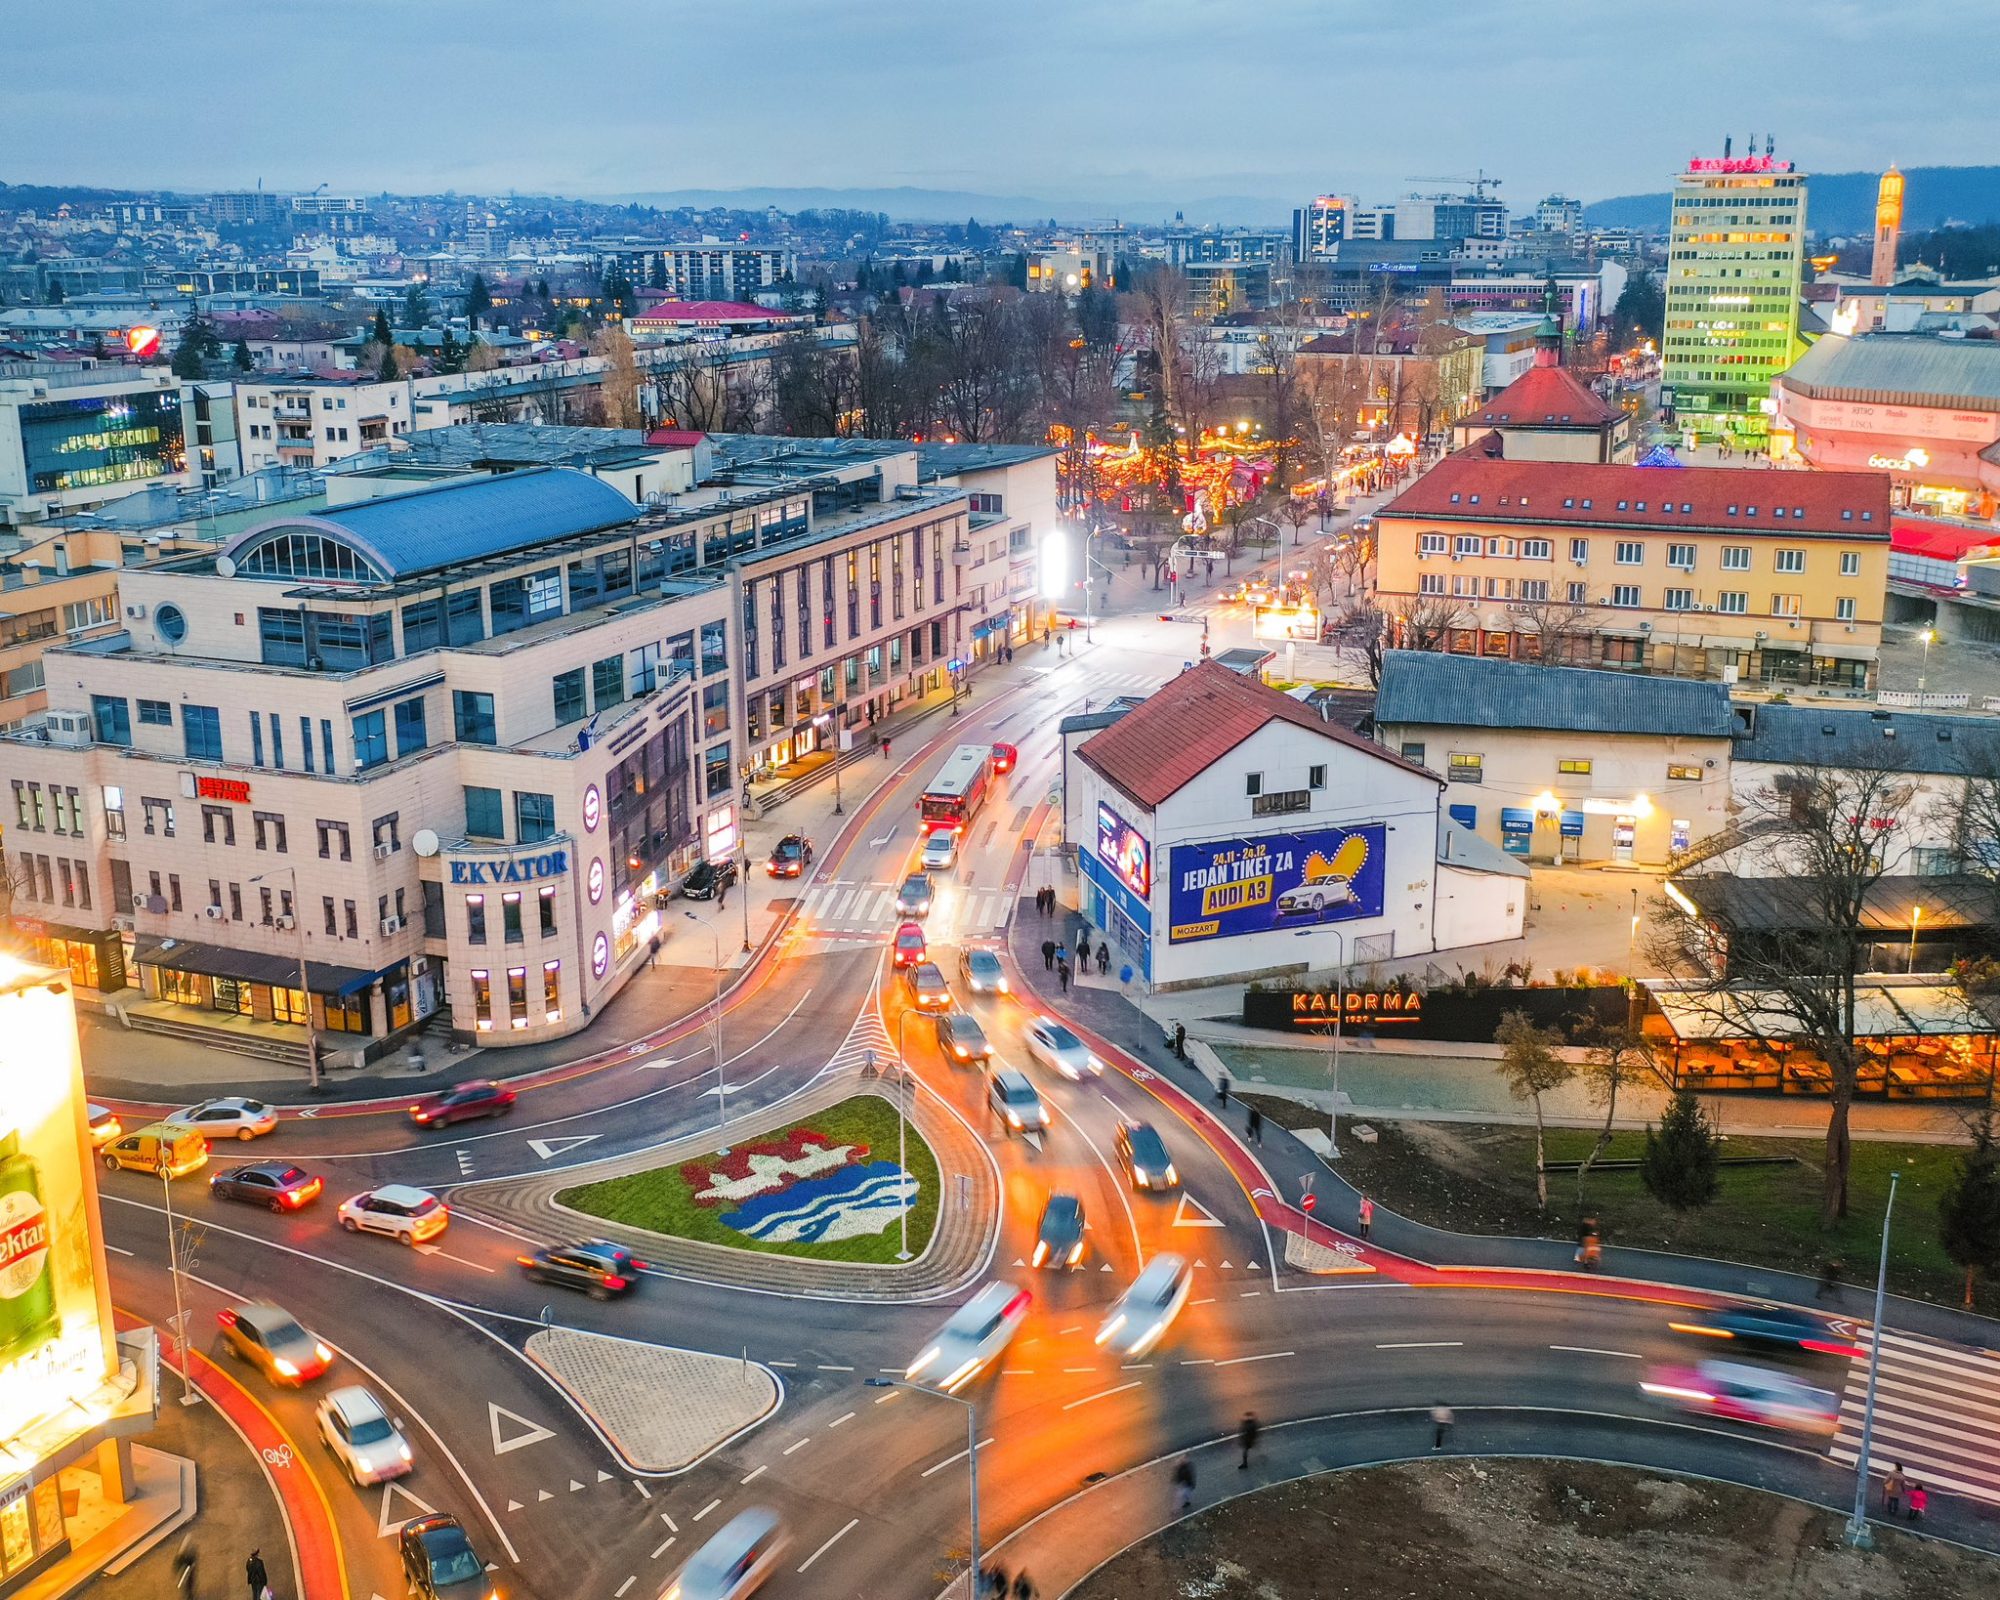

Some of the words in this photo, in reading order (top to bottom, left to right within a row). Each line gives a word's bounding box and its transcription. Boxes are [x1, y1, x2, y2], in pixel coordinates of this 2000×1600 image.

[199, 788, 251, 804] PETROL
[1505, 821, 1529, 829] BEKO
[1213, 850, 1235, 866] 24.11
[1242, 844, 1266, 860] 24.12
[449, 851, 568, 884] EKVATOR
[1182, 864, 1228, 892] JEDAN
[1231, 855, 1272, 881] TIKET
[1275, 851, 1294, 873] ZA
[1208, 884, 1243, 910] AUDI
[1247, 880, 1267, 902] A3
[1177, 923, 1215, 936] MOZZART
[1293, 992, 1420, 1011] KALDRMA
